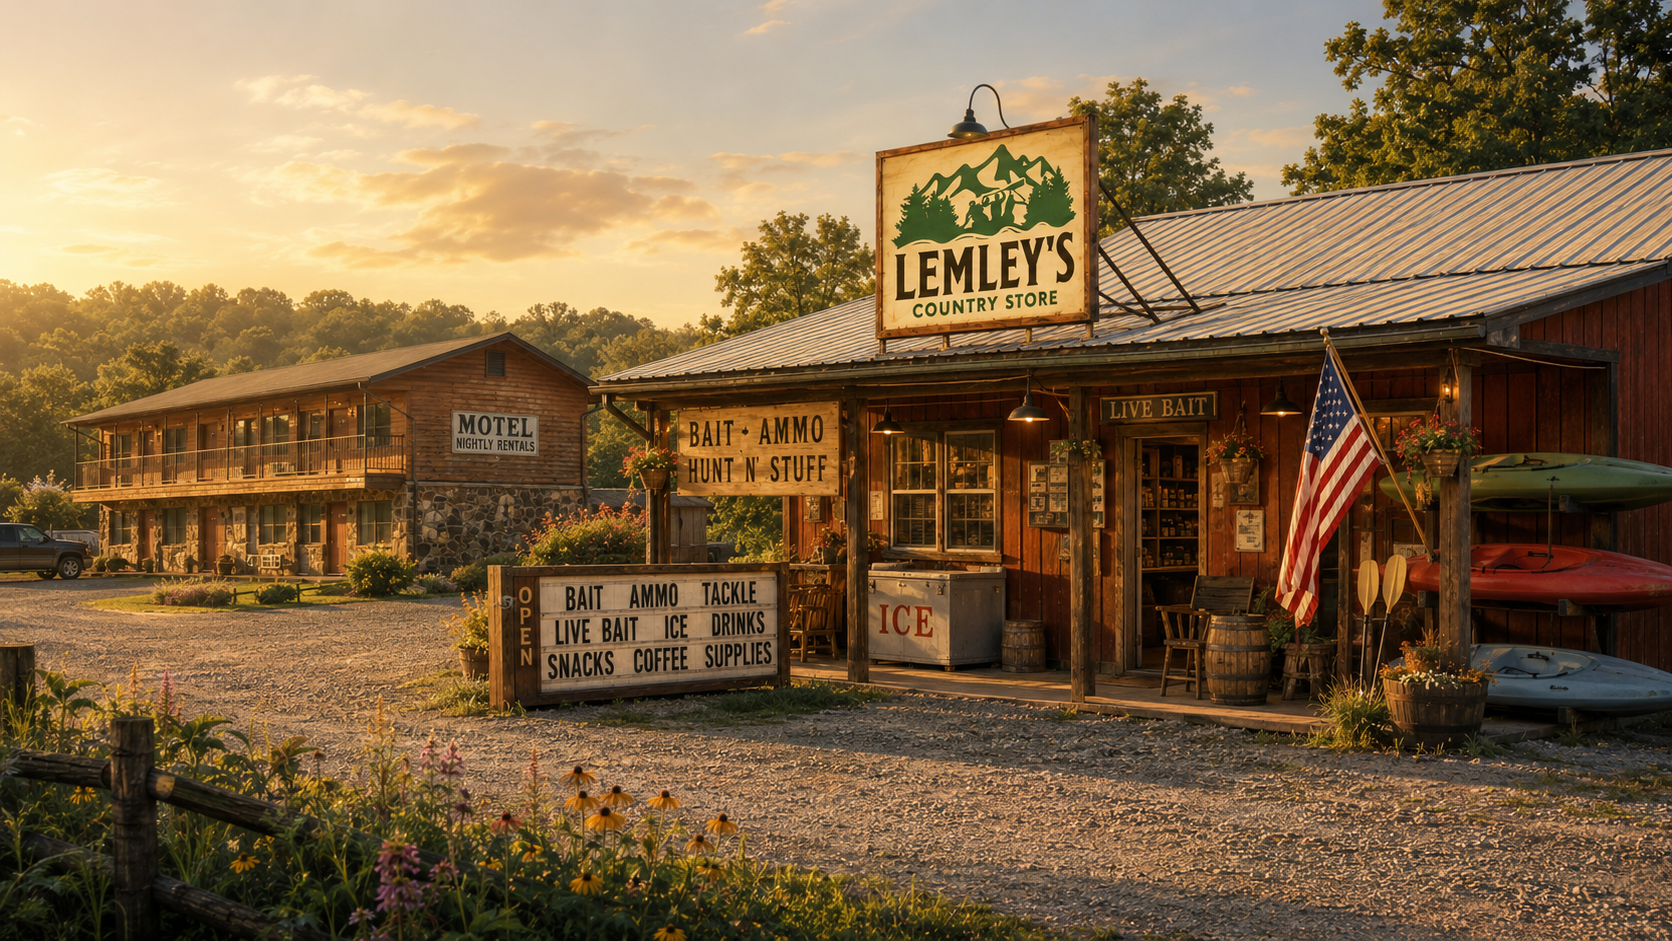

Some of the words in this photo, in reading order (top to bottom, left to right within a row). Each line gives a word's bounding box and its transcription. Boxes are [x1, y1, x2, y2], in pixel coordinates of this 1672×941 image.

[895, 232, 1075, 300] LEMLEY'S
[912, 295, 998, 318] COUNTRY
[1005, 290, 1058, 309] STORE
[1110, 400, 1153, 419] LIVE
[1161, 397, 1207, 417] BAIT
[457, 414, 533, 437] MOTEL
[689, 420, 734, 447] BAIT
[758, 414, 824, 445] AMMO
[456, 437, 494, 450] NIGHTLY
[497, 440, 535, 452] RENTALS
[688, 457, 734, 484] HUNT
[745, 456, 760, 483] N'
[770, 455, 827, 482] STUFF
[565, 585, 603, 611] BAIT
[629, 582, 678, 609] AMMO
[702, 580, 757, 606] TACKLE
[518, 586, 533, 666] OPEN
[555, 619, 590, 645] LIVE
[602, 616, 639, 643] BAIT
[664, 614, 688, 639] ICE
[711, 611, 765, 637] DRINKS
[879, 604, 934, 638] ICE
[547, 650, 615, 680] SNACKS
[633, 646, 689, 673] COFFEE
[705, 641, 772, 669] SUPPLIES
